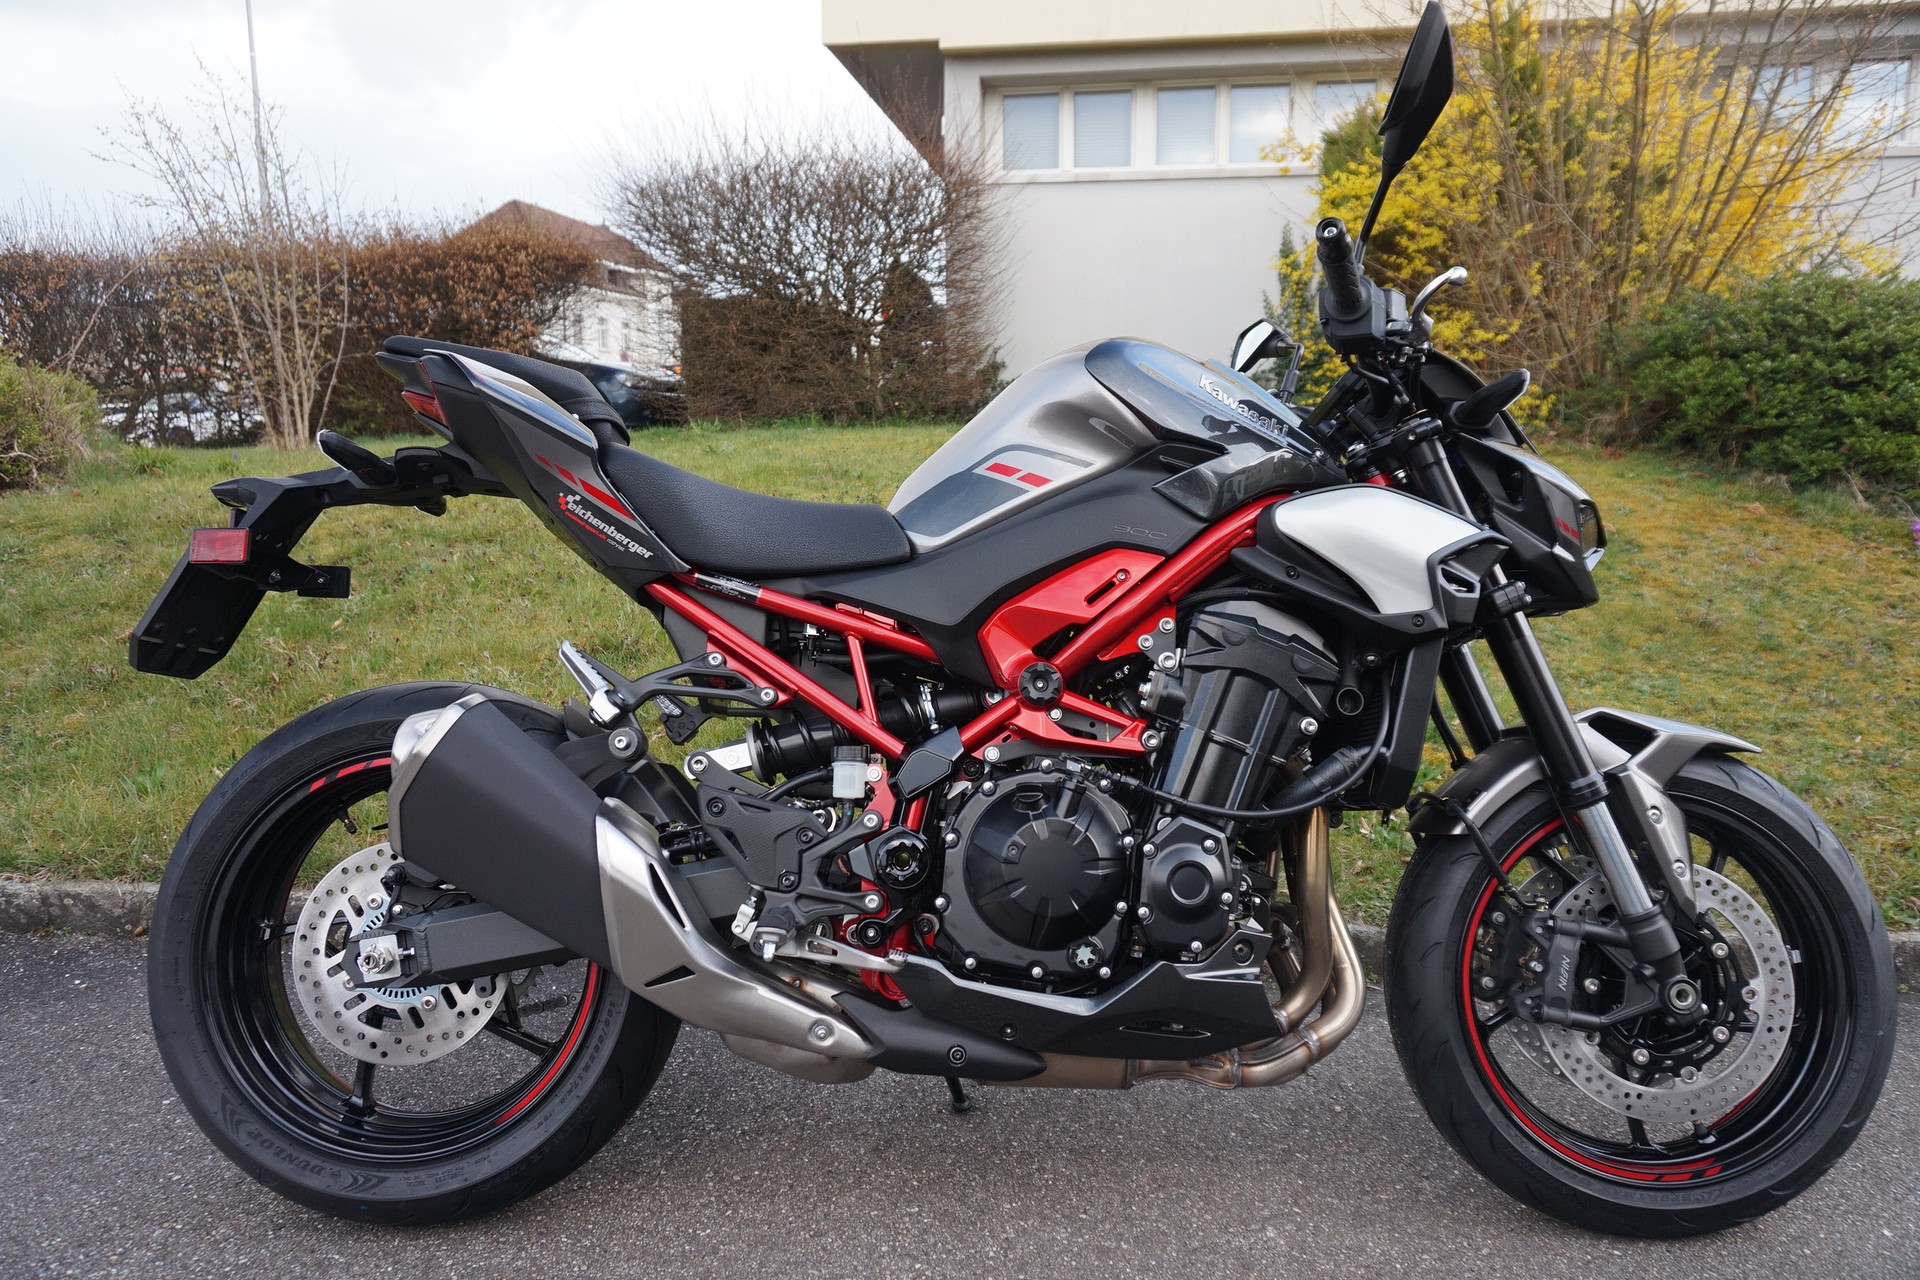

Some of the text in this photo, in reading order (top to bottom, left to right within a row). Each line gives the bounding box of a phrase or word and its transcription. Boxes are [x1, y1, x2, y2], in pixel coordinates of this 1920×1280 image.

[1199, 373, 1289, 439] Kawasaki
[567, 501, 654, 559] eichenberger
[1114, 524, 1168, 540] 900
[246, 1126, 325, 1177] DUNLOP
